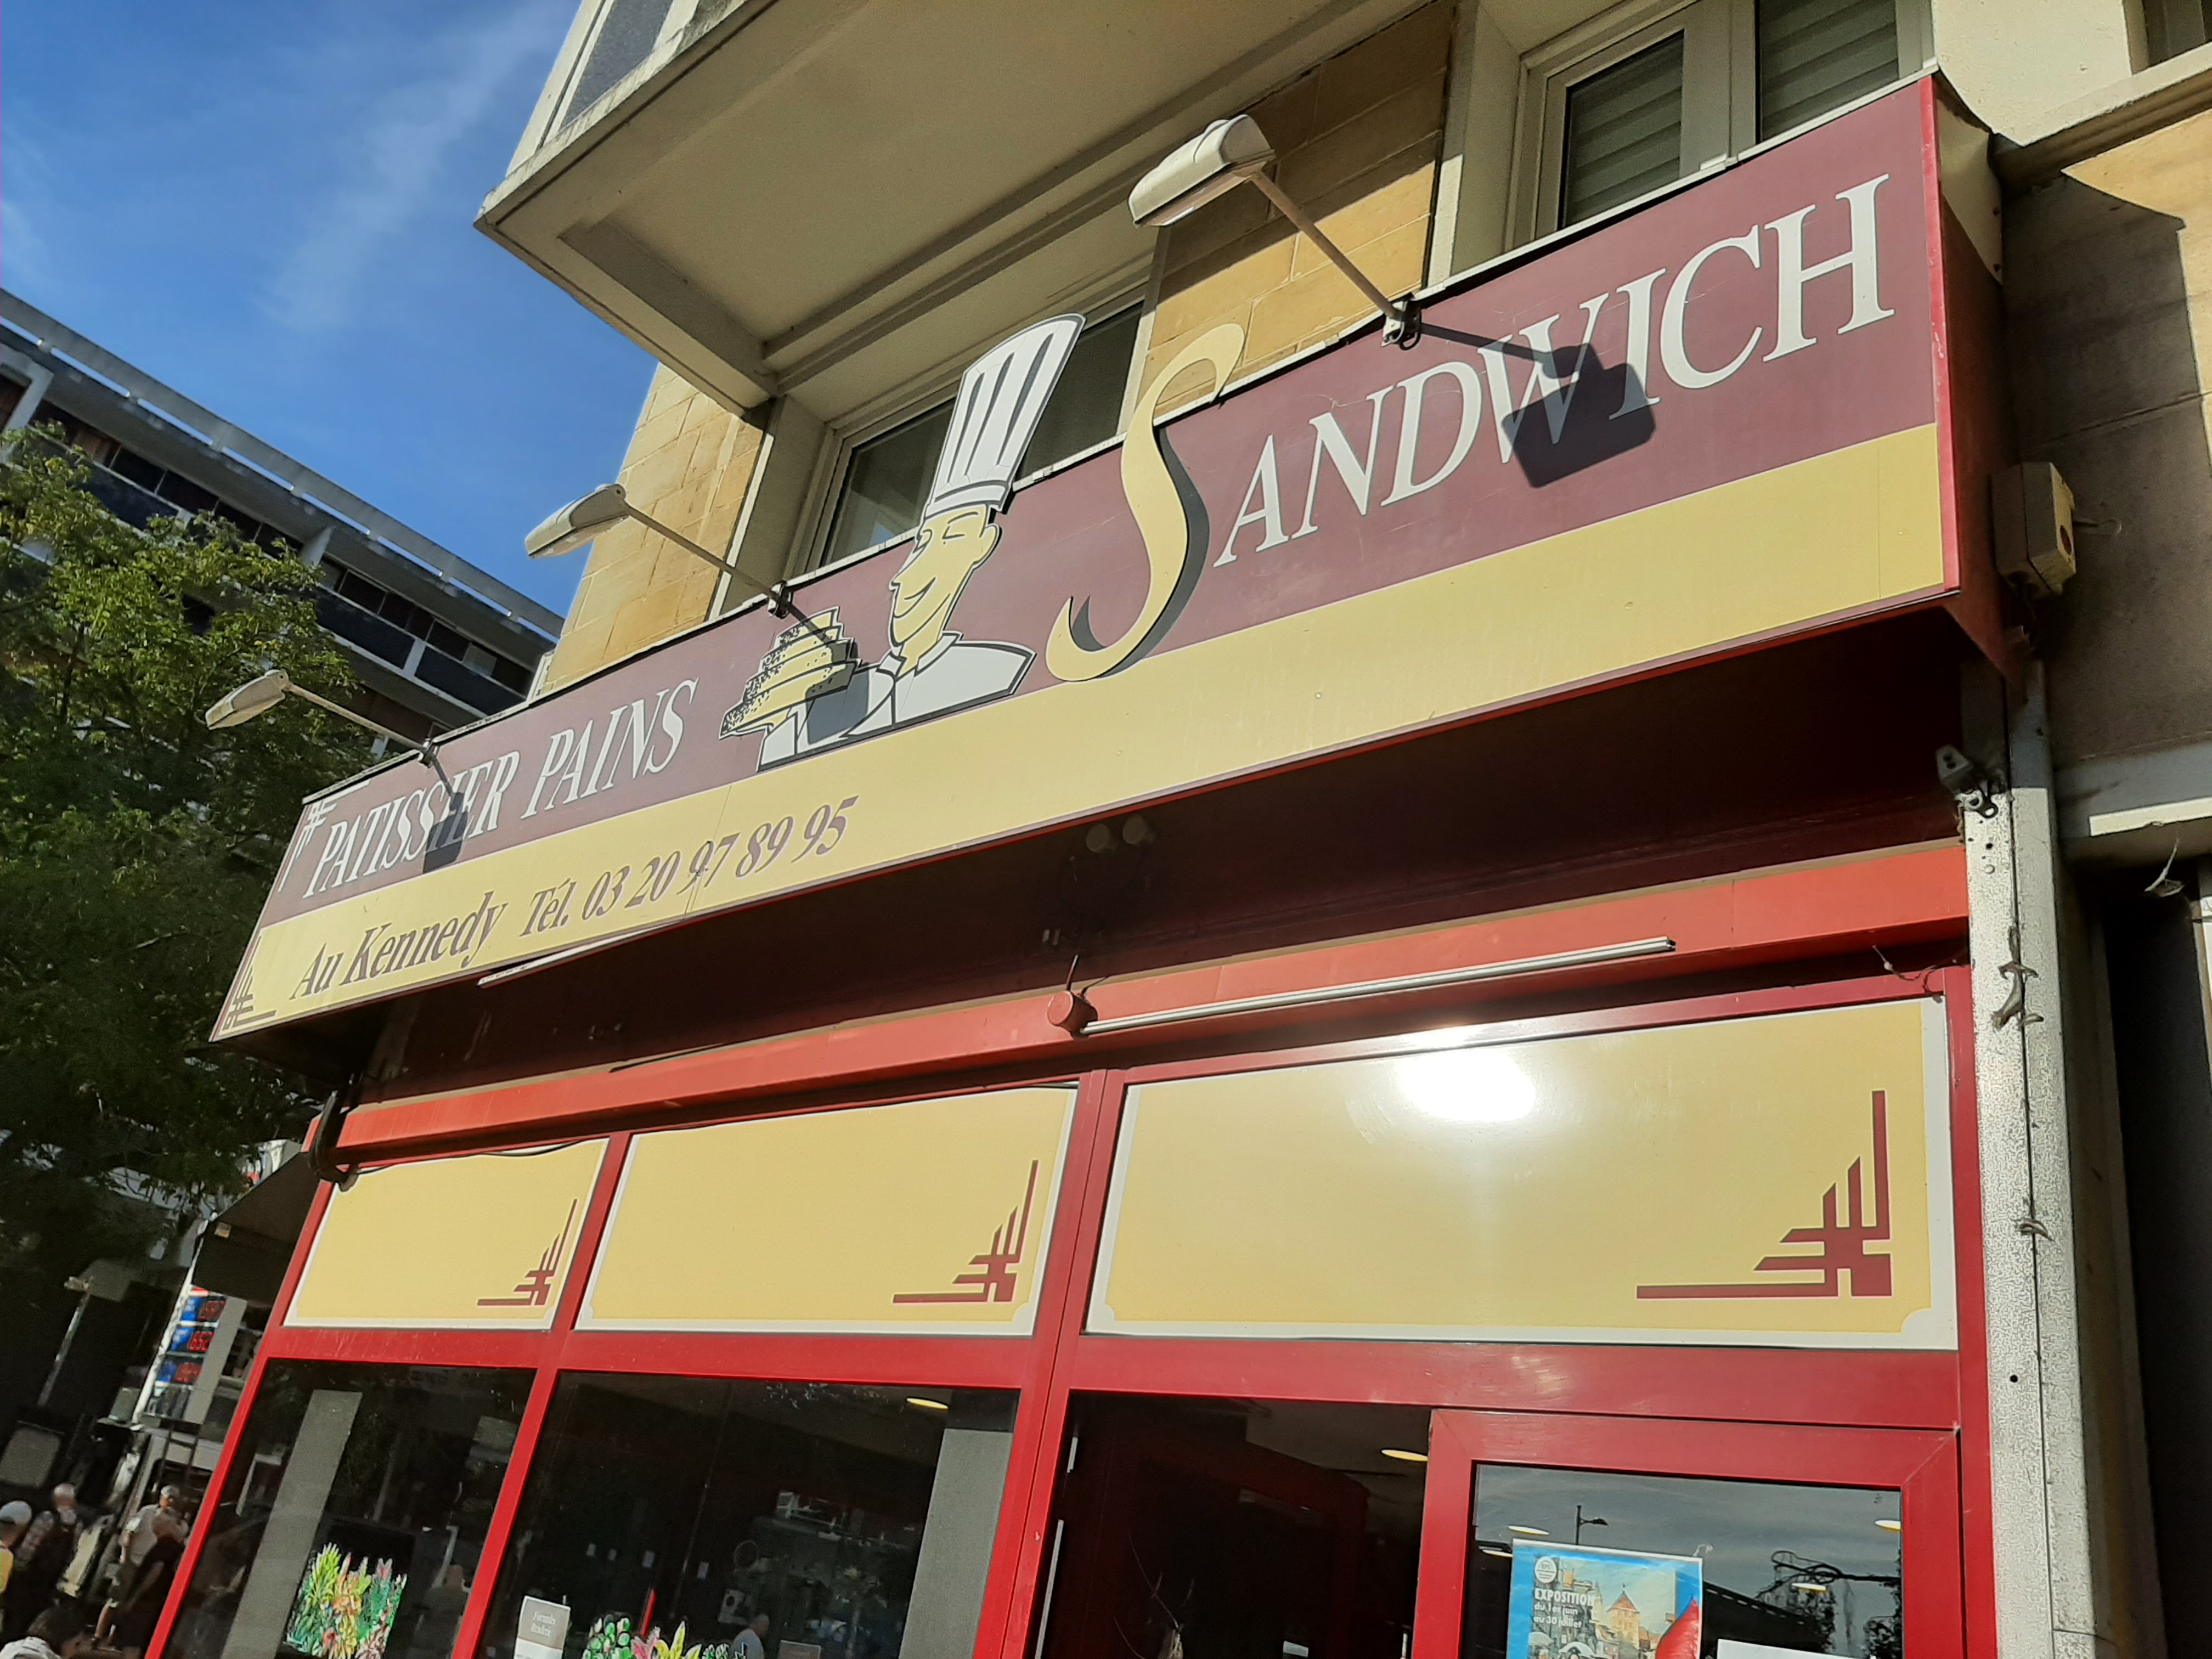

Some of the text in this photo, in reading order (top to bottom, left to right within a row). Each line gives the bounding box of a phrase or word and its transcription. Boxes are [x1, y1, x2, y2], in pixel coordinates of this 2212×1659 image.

[1046, 174, 1894, 681] SANDWICH
[302, 677, 699, 899] PATISSIER PAINS
[289, 795, 859, 1001] Au Kennedy Tél. 03 20 97 89 95
[1534, 1587, 1594, 1606] EXPOSITION
[1534, 1601, 1545, 1611] du
[1562, 1605, 1578, 1615] juin
[1546, 1616, 1557, 1624] 30
[1559, 1616, 1582, 1628] juillet
